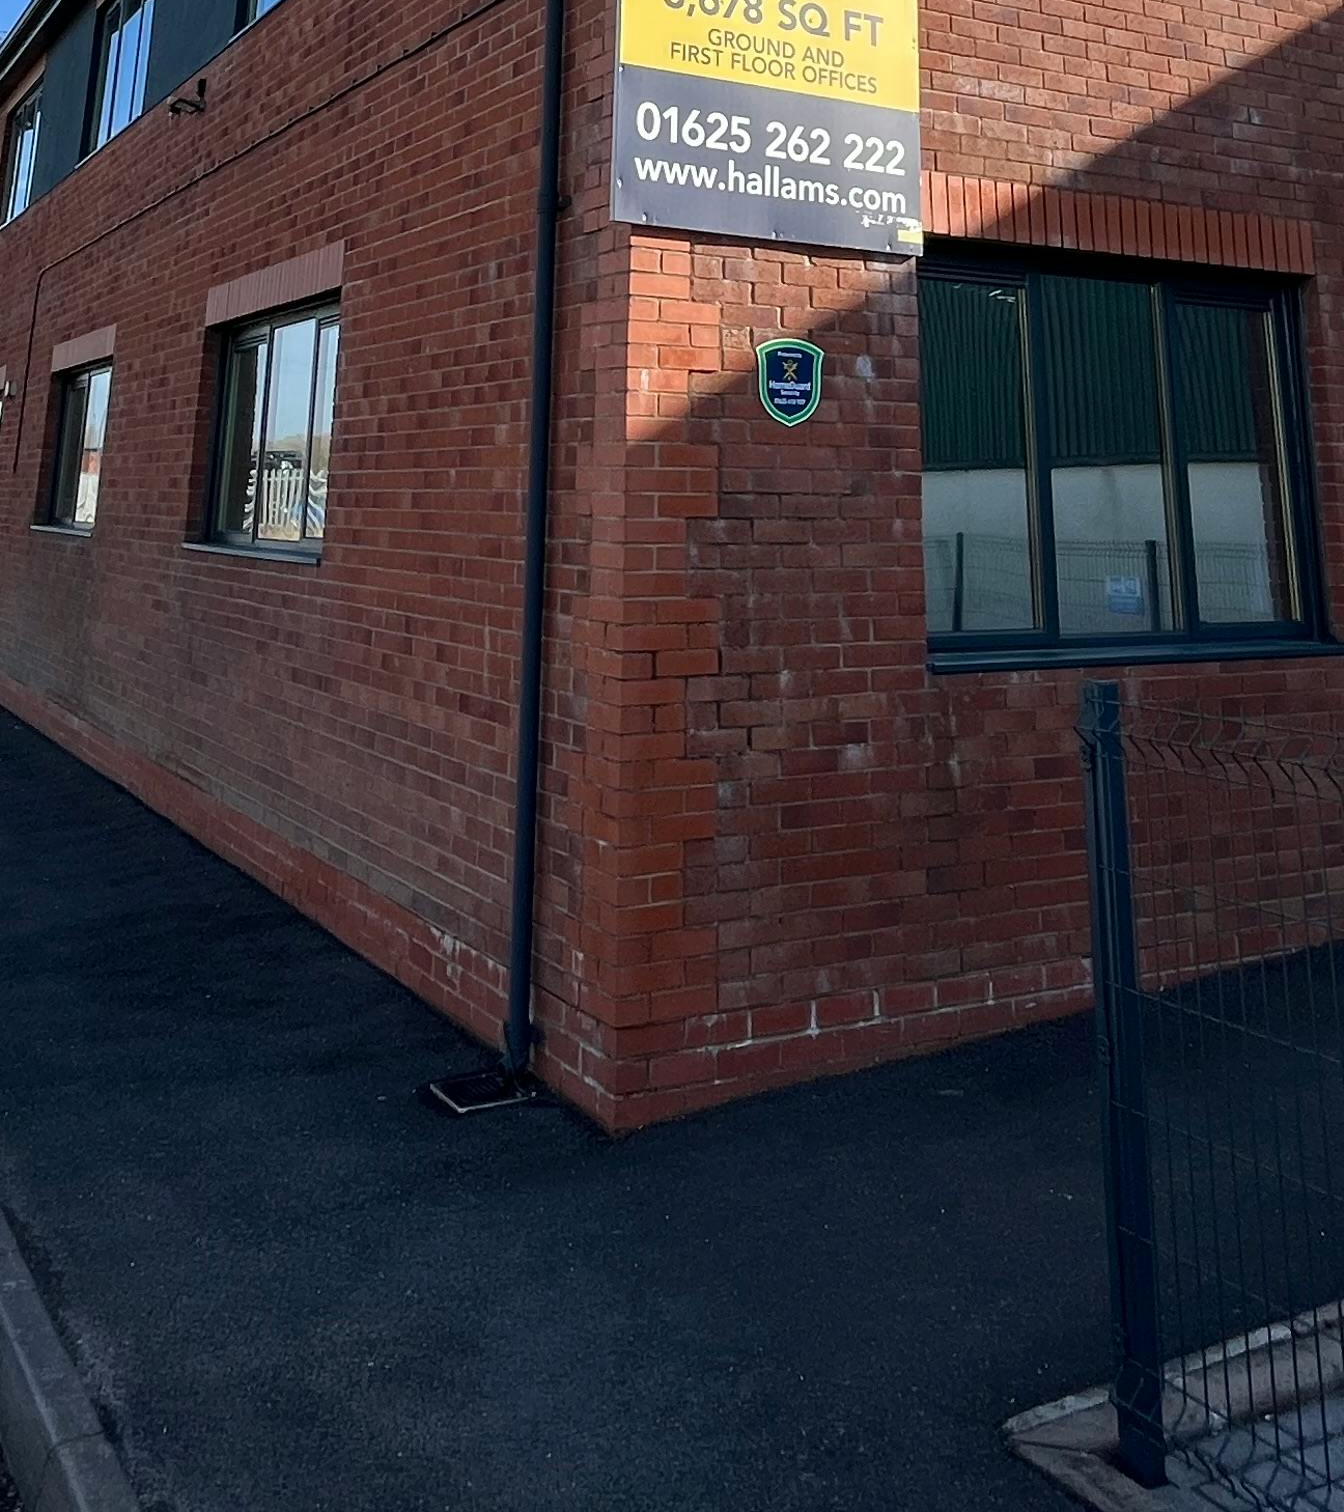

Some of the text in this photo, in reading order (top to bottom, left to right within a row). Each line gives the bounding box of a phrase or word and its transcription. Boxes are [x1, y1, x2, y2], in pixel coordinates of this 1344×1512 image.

[708, 28, 844, 68] GROUND AND
[844, 10, 884, 47] FT
[670, 42, 878, 94] FIRST FLOOR OFFICES
[636, 101, 905, 176] 01625 262 222
[634, 156, 906, 214] www.hallams.com
